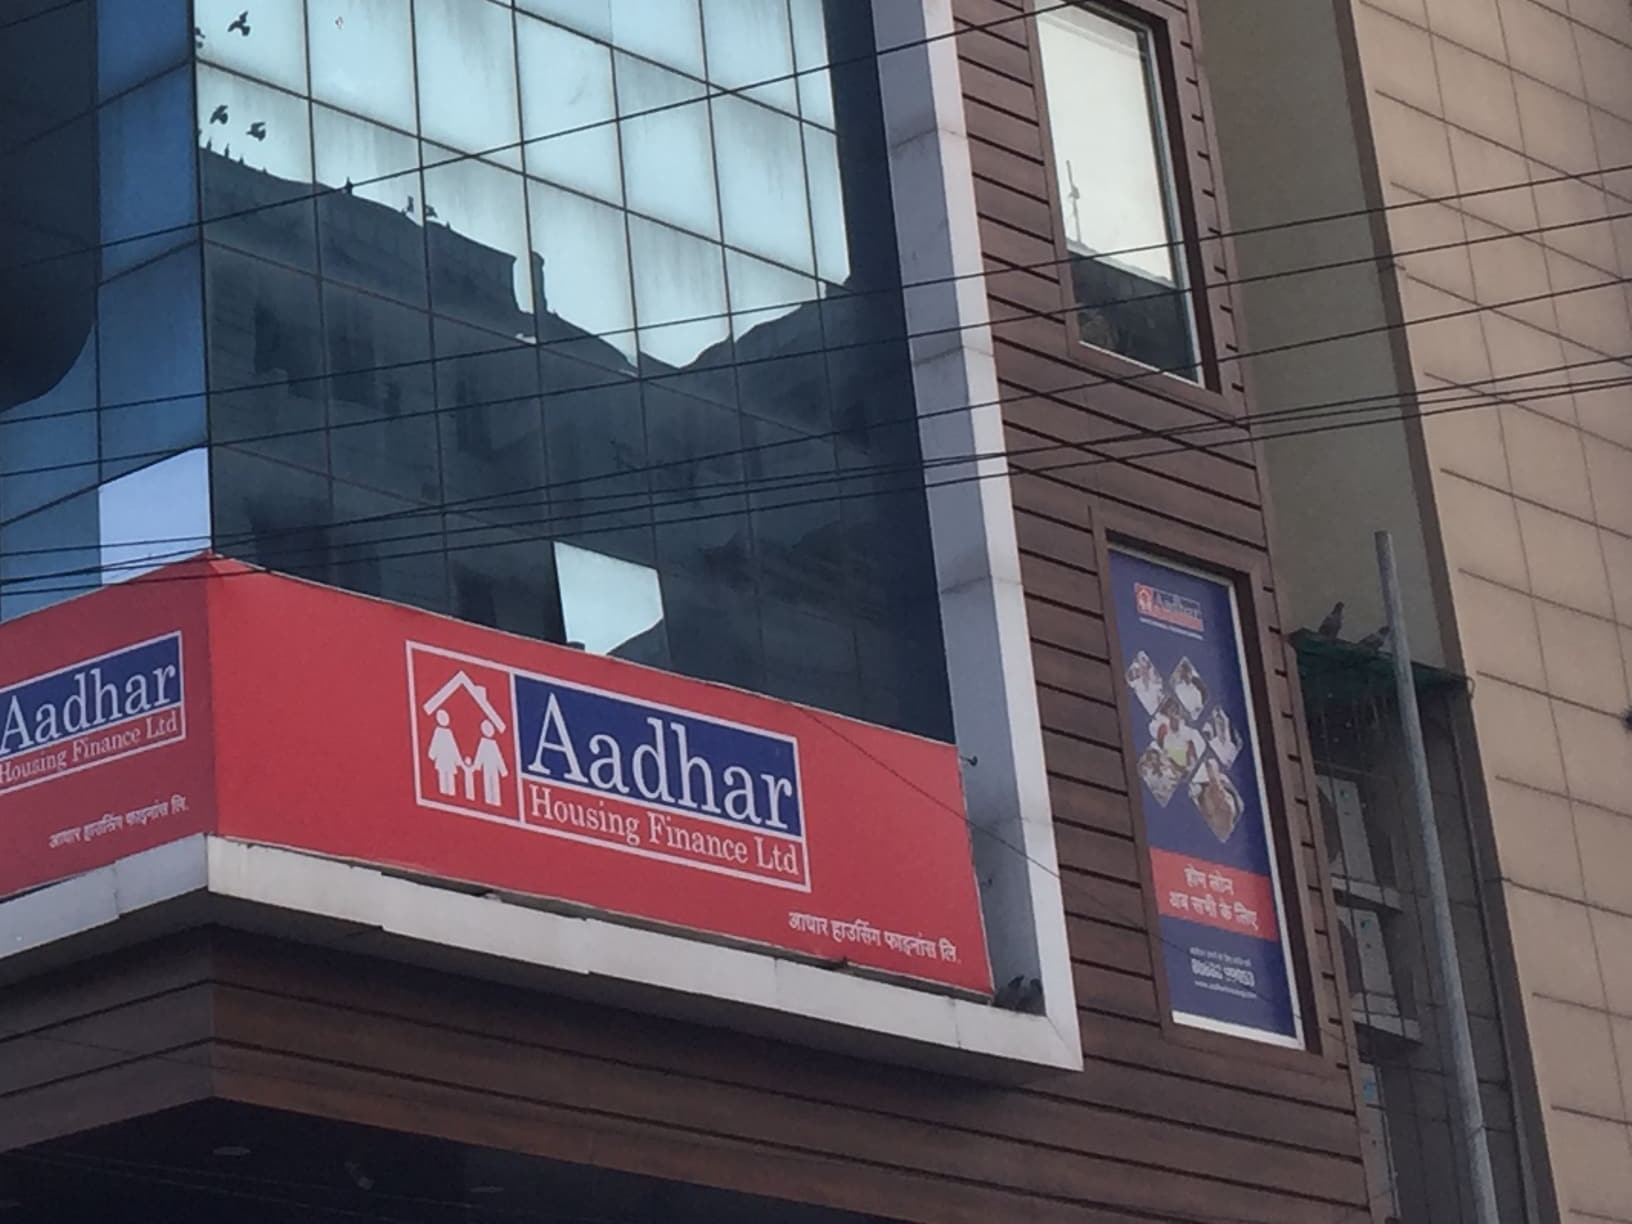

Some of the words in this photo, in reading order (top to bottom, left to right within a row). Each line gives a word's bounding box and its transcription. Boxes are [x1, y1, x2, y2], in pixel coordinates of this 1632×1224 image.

[71, 727, 141, 763] Finance
[145, 710, 178, 739] Ltd
[528, 692, 793, 829] Aadhar
[529, 783, 640, 846] Housing
[646, 810, 749, 864] Finance
[754, 835, 800, 875] Ltd
